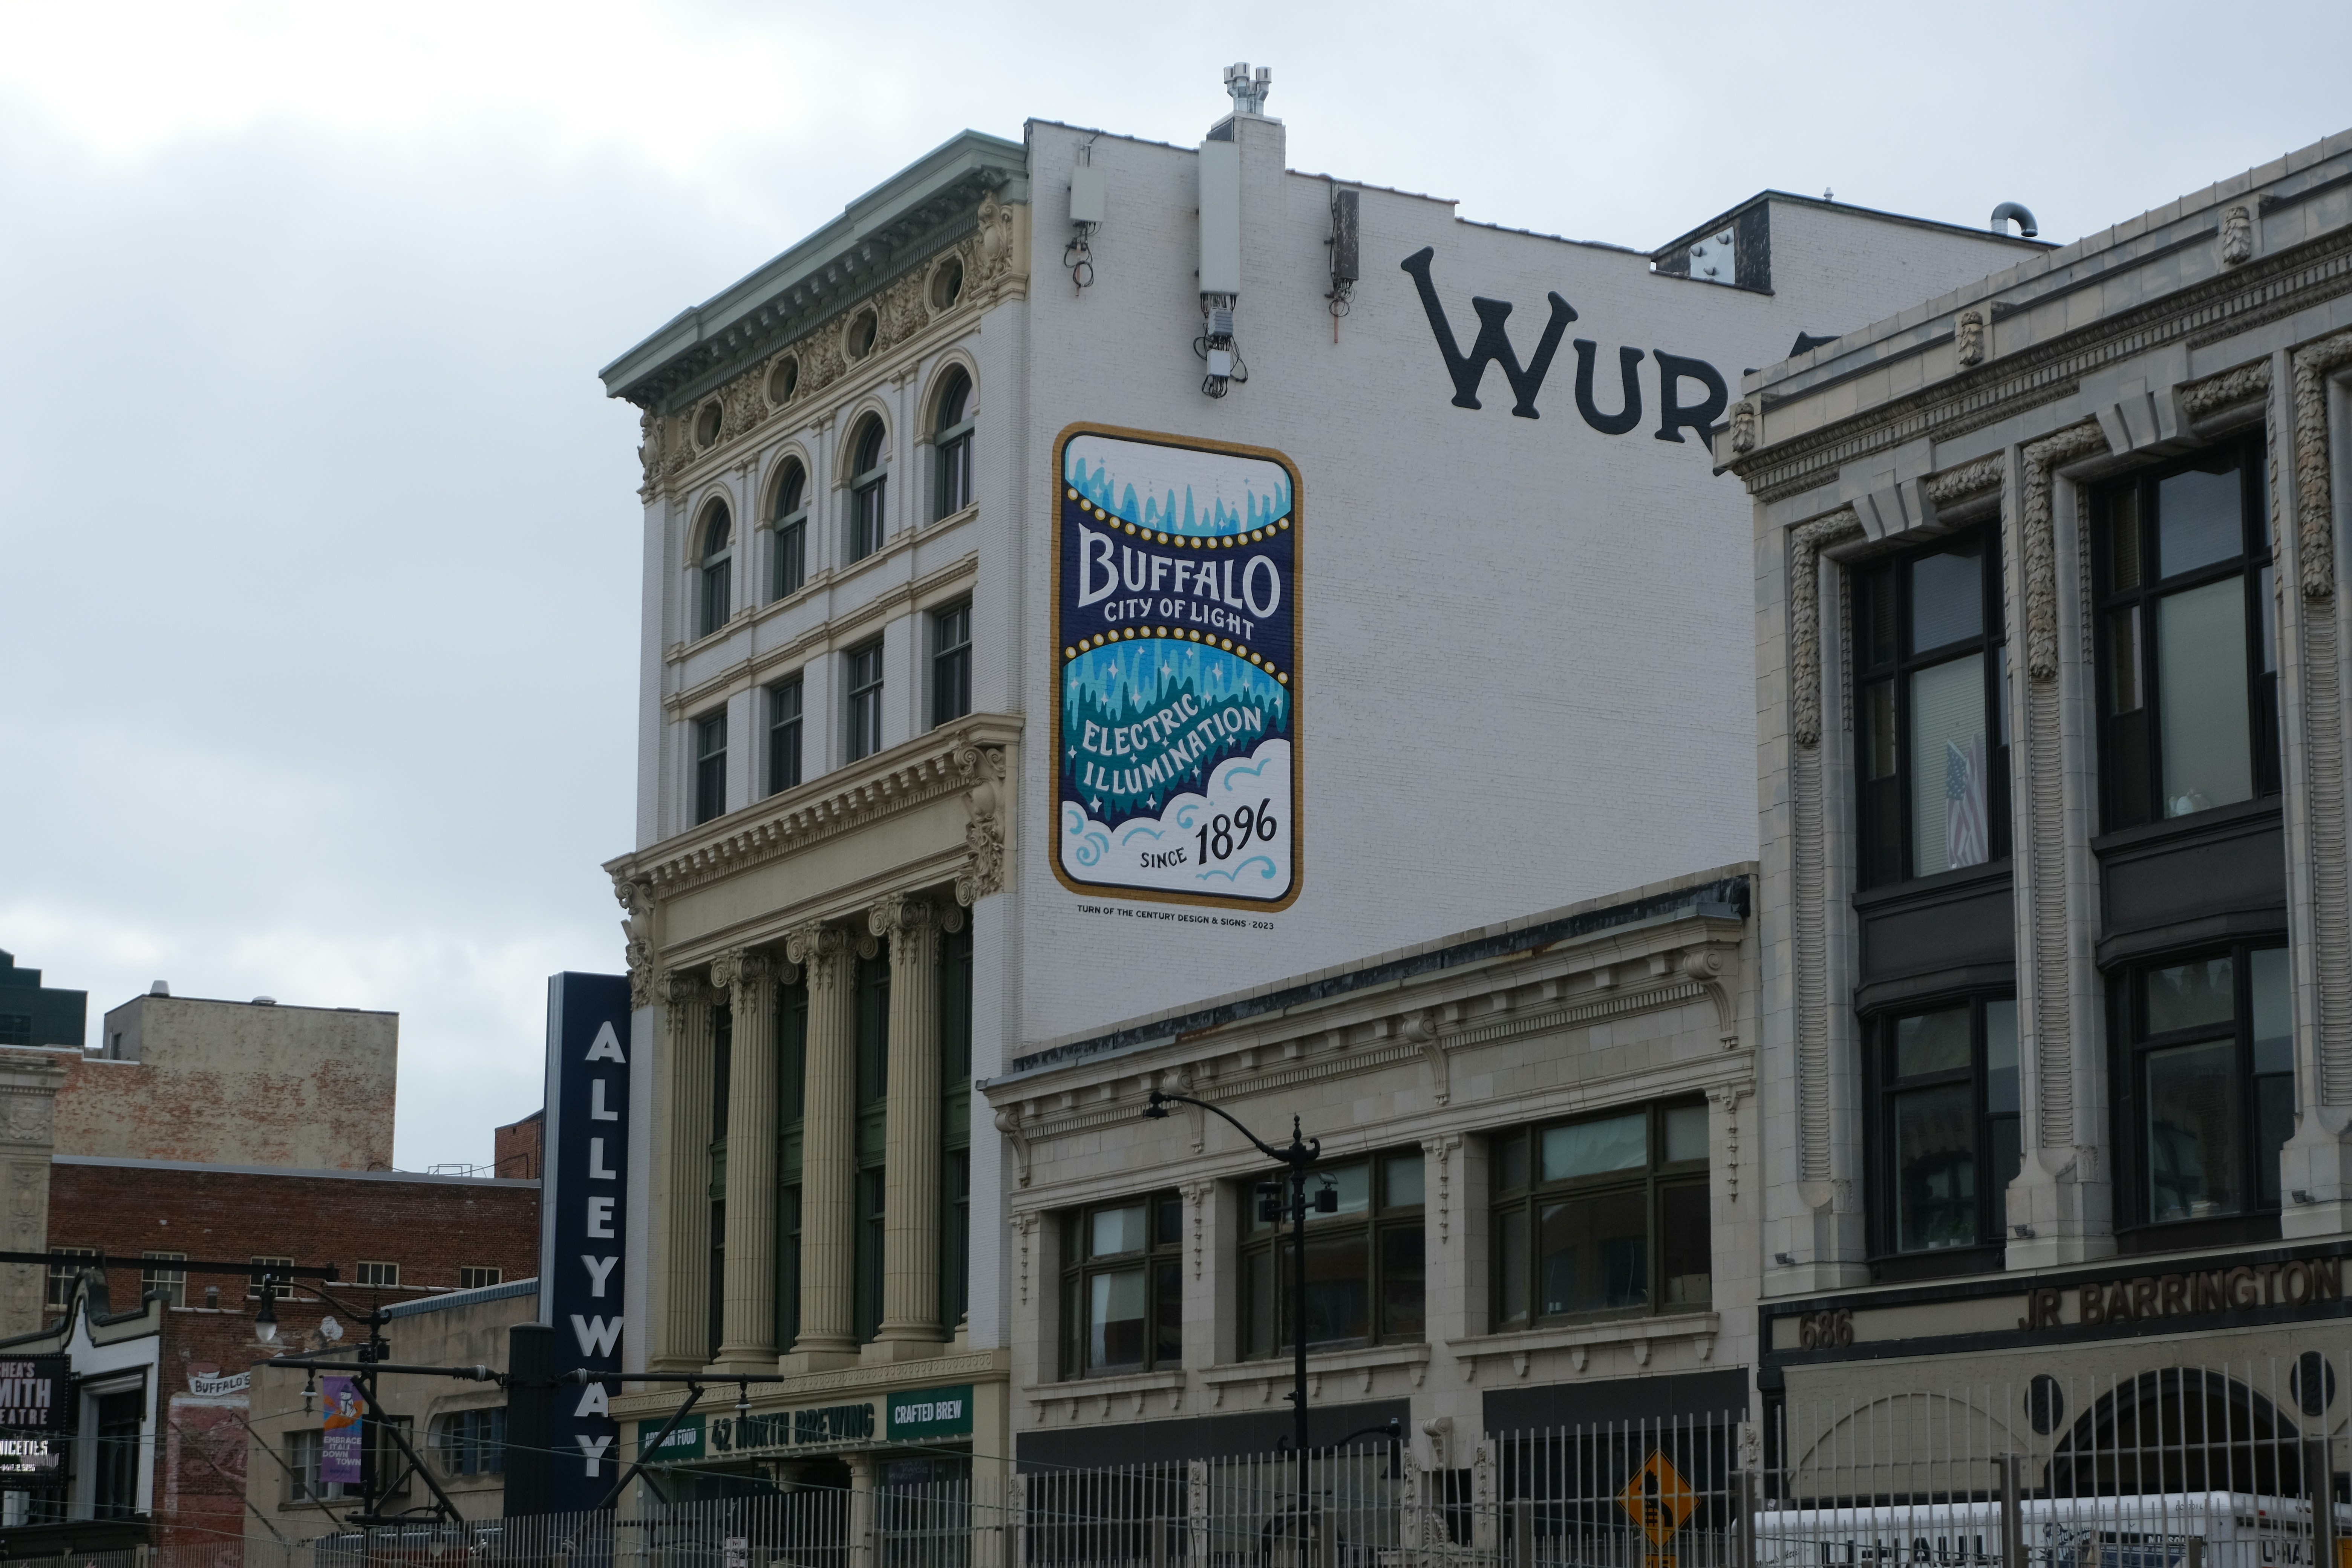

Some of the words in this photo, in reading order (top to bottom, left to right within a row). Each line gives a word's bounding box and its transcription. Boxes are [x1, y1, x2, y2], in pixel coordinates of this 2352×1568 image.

[1078, 522, 1281, 618] BUFFALO
[1104, 597, 1152, 622] CITY
[1160, 598, 1186, 619] OF
[1190, 602, 1254, 640] LIGHT
[1083, 694, 1198, 756] ELECTRIC
[1083, 706, 1261, 794] ILLUMINATION
[1140, 847, 1188, 868] SINCE
[1195, 798, 1277, 865] 1896
[1077, 905, 1101, 914] TURN
[1103, 907, 1115, 915] OF
[1117, 908, 1133, 917] THE
[1136, 910, 1175, 921] CENTURY
[1178, 914, 1209, 924] DESIGN
[1220, 918, 1246, 927] SIGNS
[1252, 921, 1274, 929] 2023
[2018, 1287, 2062, 1331] JR
[2079, 1256, 2342, 1326] BARRINGTON
[1799, 1308, 1853, 1351] 686
[0, 1362, 35, 1378] HEA'S
[195, 1374, 251, 1393] BUFFALO'S
[711, 1418, 732, 1451] 42
[735, 1412, 790, 1449] NORTH
[795, 1402, 875, 1444] BREWING
[895, 1403, 934, 1424] CRAFTED
[936, 1399, 962, 1421] BREW
[324, 1436, 362, 1444] EMBRACE
[677, 1427, 697, 1446] FOOD
